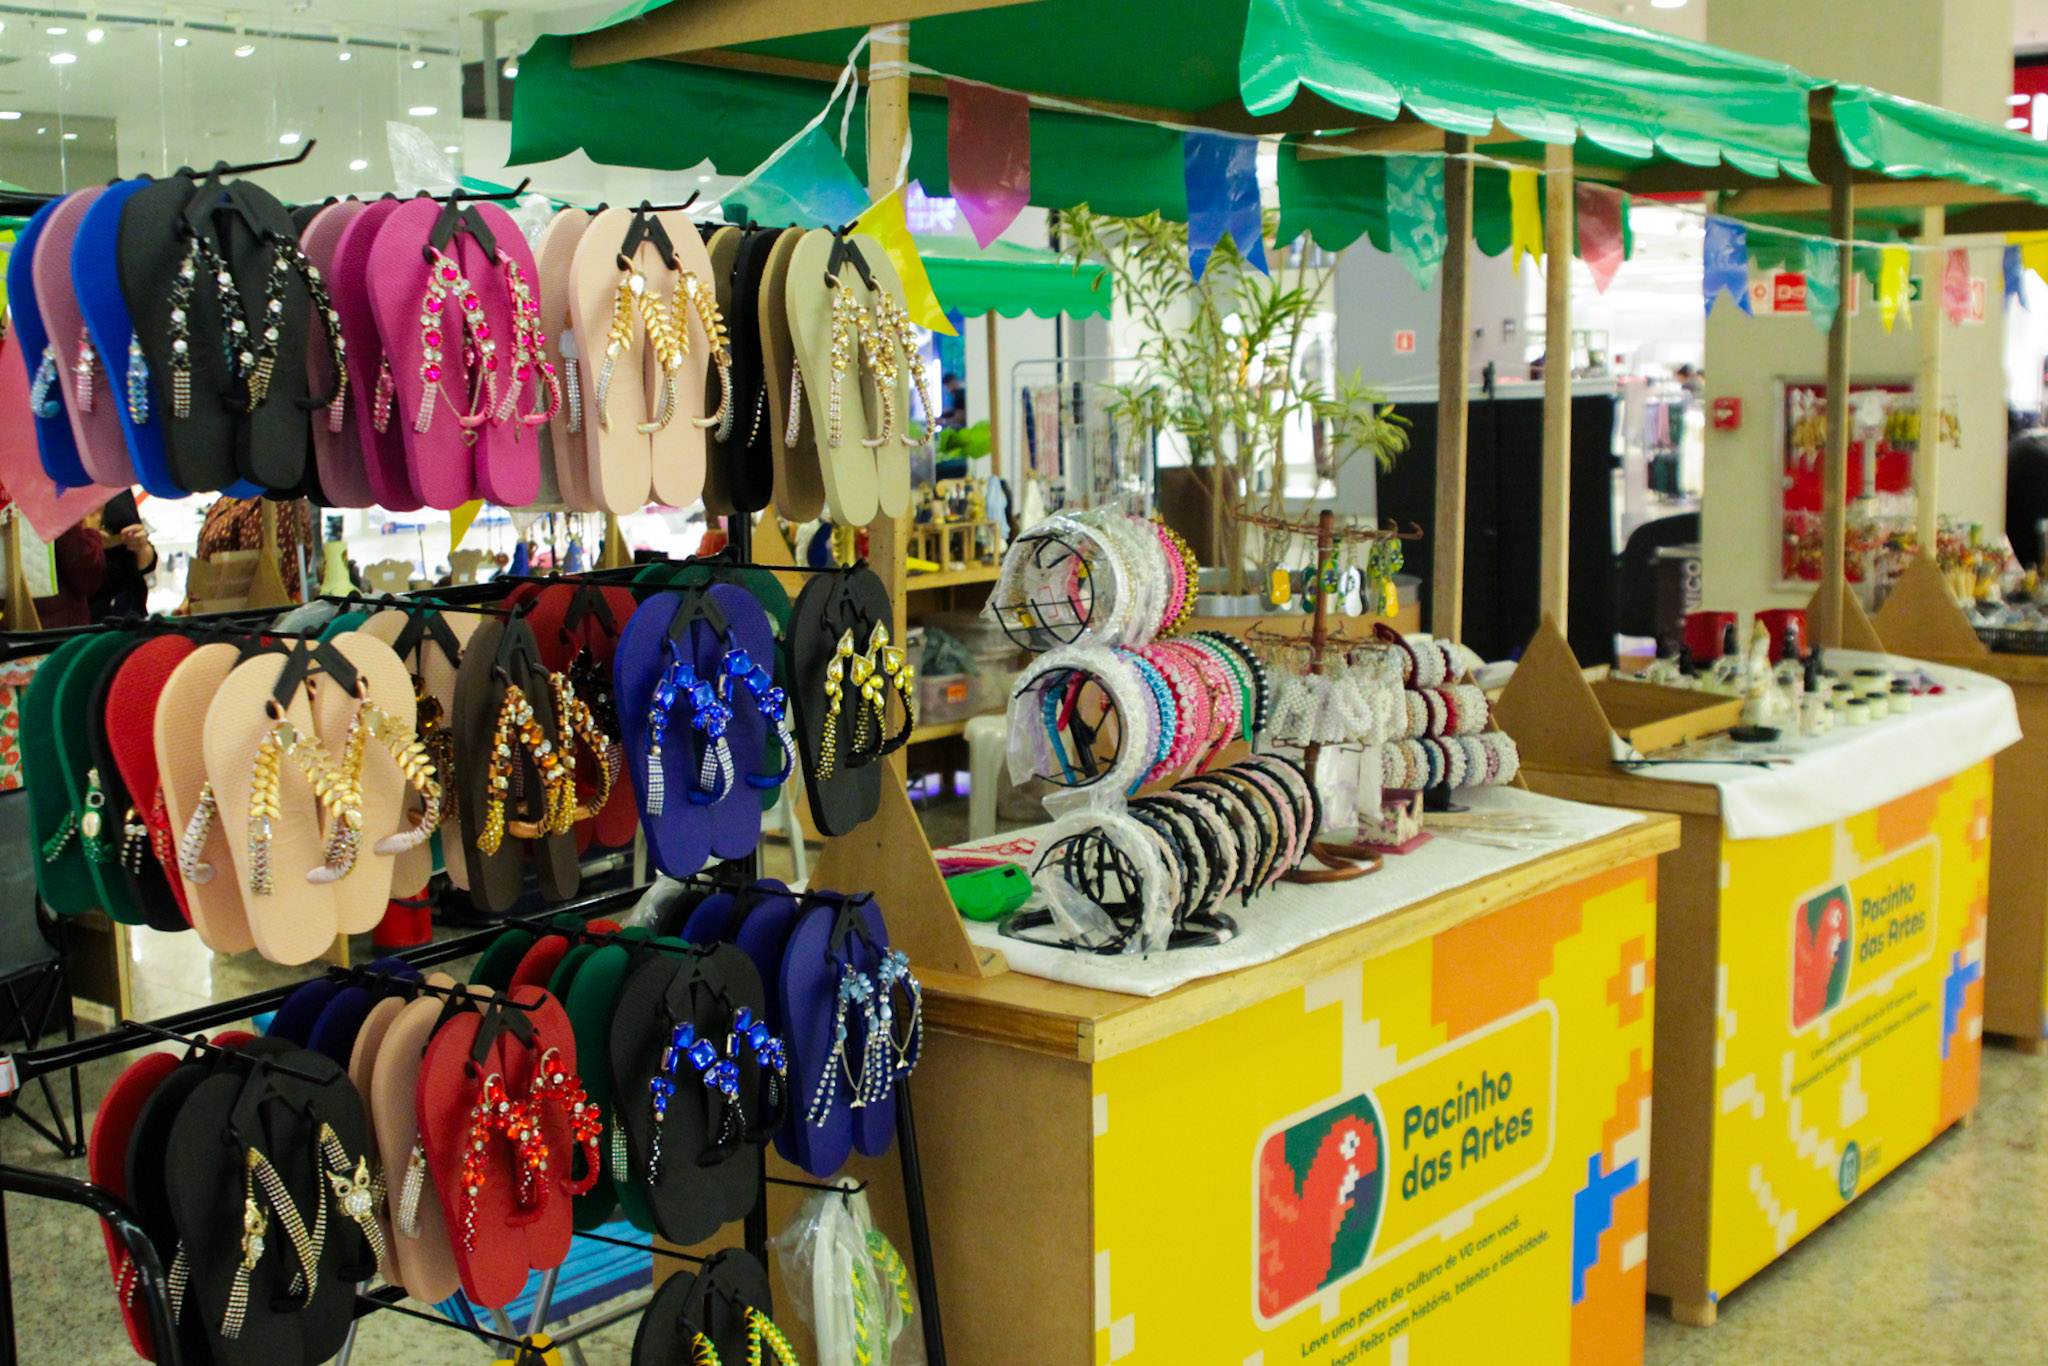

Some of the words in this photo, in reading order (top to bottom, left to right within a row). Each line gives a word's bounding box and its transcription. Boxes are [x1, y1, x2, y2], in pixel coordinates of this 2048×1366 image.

[1859, 933, 1884, 963] das
[1888, 910, 1926, 947] Artes
[1862, 880, 1916, 928] Pacinho
[1402, 1150, 1452, 1201] das
[1461, 1107, 1533, 1170] Artes
[1403, 1070, 1512, 1151] Pacinho
[1301, 1333, 1329, 1358] Leve
[1332, 1317, 1355, 1339] uma
[1358, 1297, 1388, 1328] parte
[1390, 1287, 1404, 1303] da
[1406, 1265, 1442, 1294] cultura
[1445, 1254, 1457, 1270] de
[1459, 1242, 1474, 1260] VG
[1476, 1233, 1496, 1251] com
[1361, 1332, 1385, 1355] feito
[1388, 1317, 1409, 1338] com
[1455, 1266, 1490, 1295] talento
[1492, 1262, 1499, 1272] e
